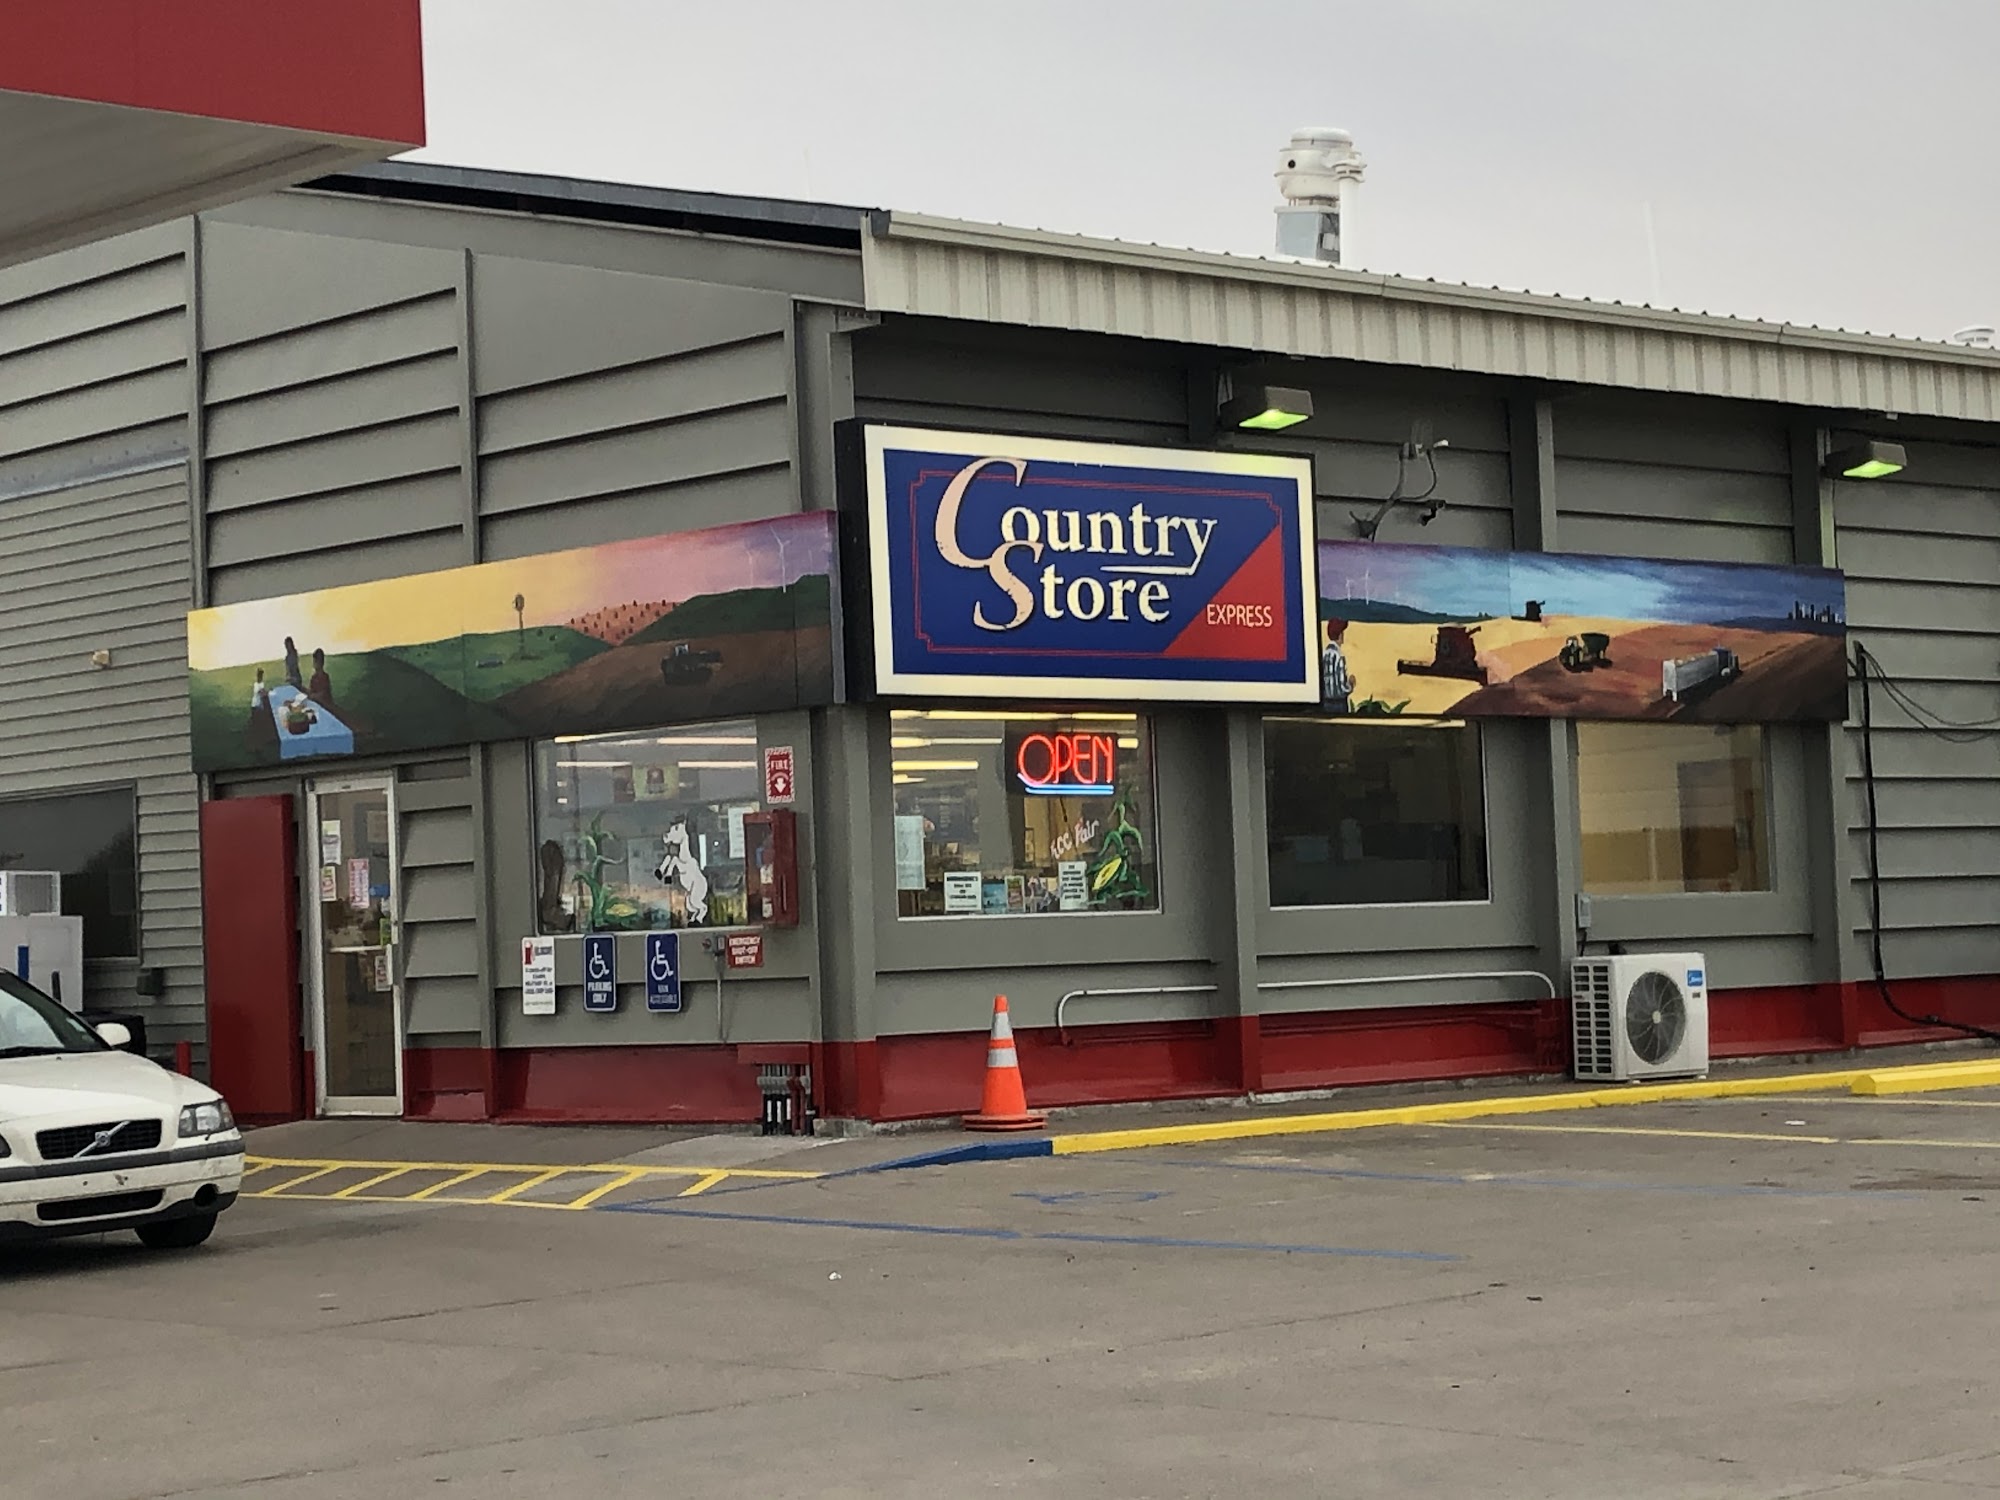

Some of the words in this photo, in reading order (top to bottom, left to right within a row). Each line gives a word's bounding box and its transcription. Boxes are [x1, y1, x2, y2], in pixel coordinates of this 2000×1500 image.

[935, 457, 1218, 576] Country
[973, 540, 1171, 631] Store
[1207, 603, 1273, 628] EXPRESS
[770, 759, 789, 770] FIRE
[1018, 734, 1113, 785] OPEN
[588, 981, 612, 992] PARKING
[593, 993, 607, 1003] ONLY
